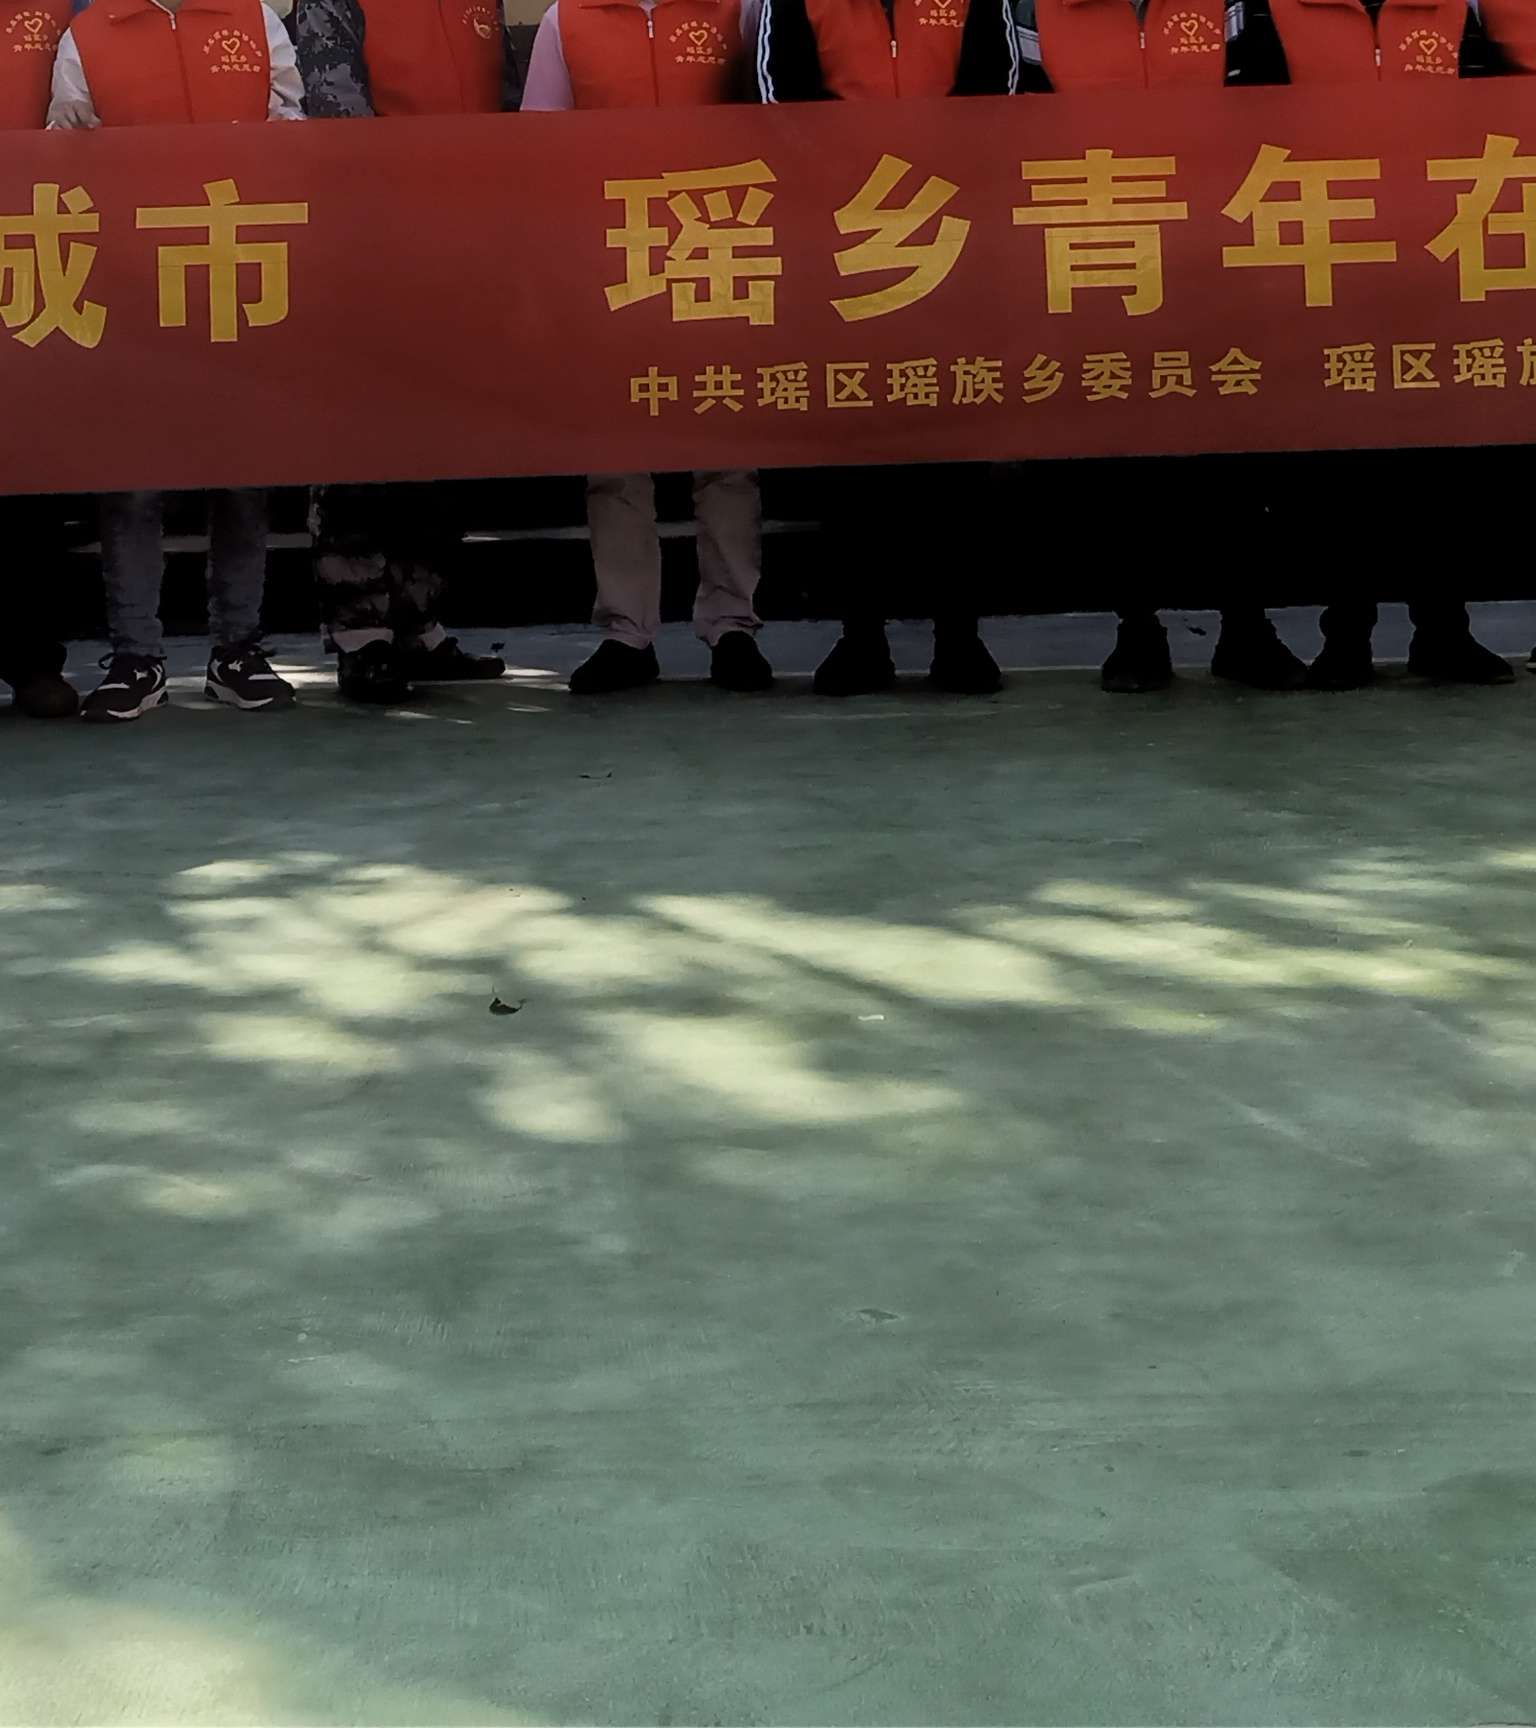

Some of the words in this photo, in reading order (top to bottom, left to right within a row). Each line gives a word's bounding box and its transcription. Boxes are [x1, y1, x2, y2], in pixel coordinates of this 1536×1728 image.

[628, 347, 1264, 417] 中共瑶区瑶族乡委员会
